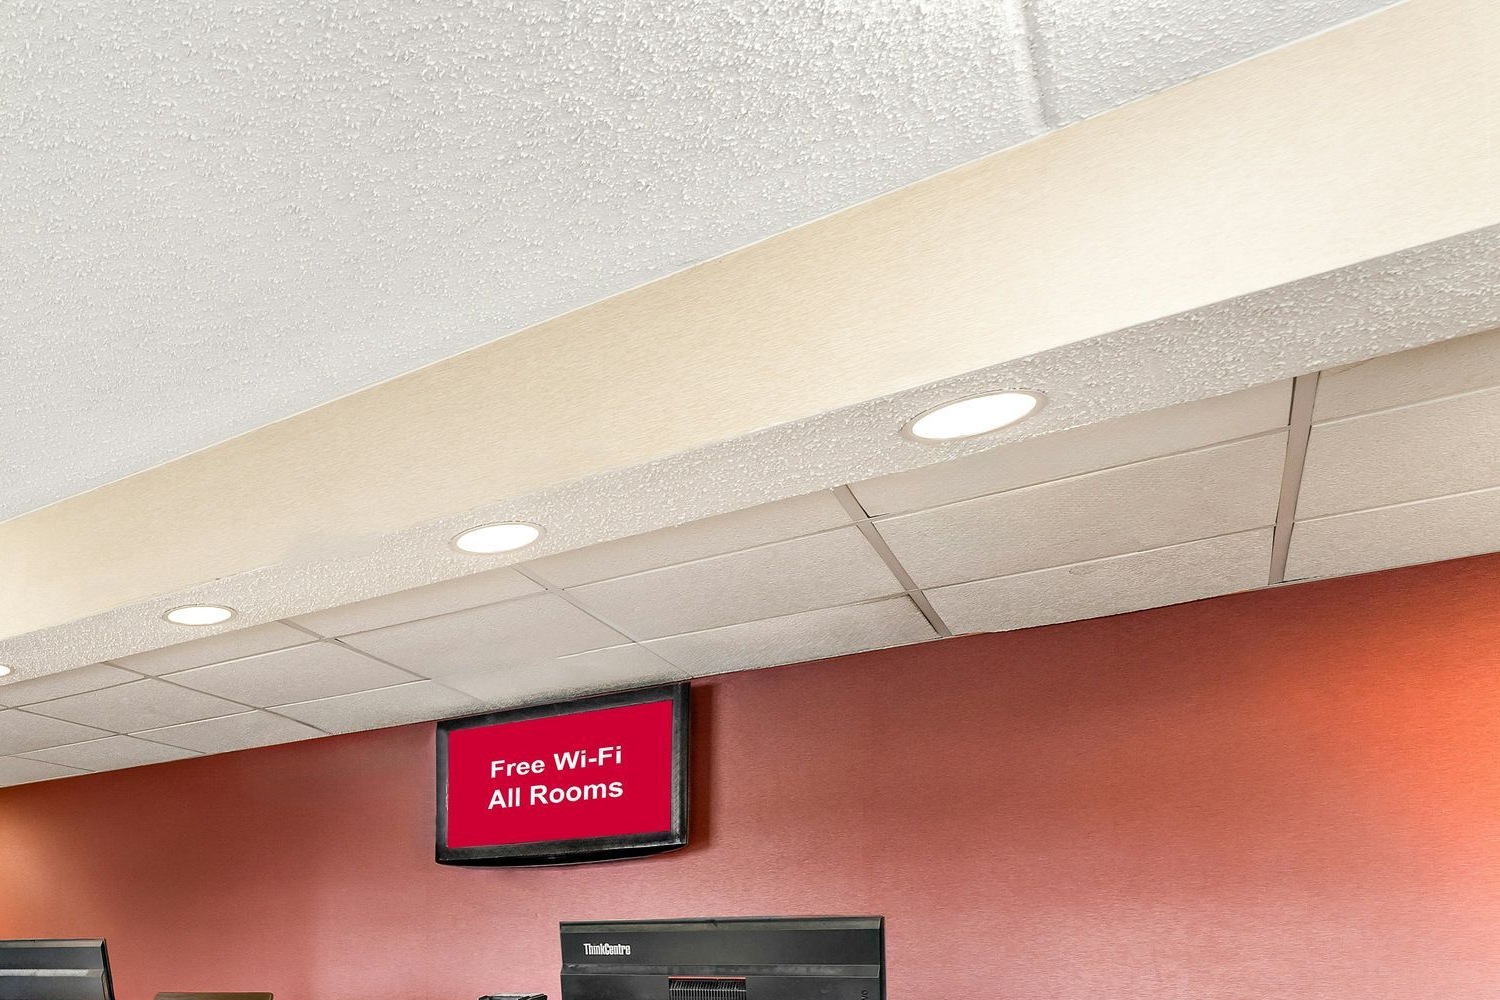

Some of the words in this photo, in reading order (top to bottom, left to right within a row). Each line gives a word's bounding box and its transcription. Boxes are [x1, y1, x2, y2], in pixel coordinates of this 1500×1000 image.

[490, 759, 546, 779] Free
[553, 745, 622, 771] Wi-Fi
[487, 787, 521, 810] All
[530, 781, 624, 806] Rooms
[583, 943, 631, 955] ThinkCentre
